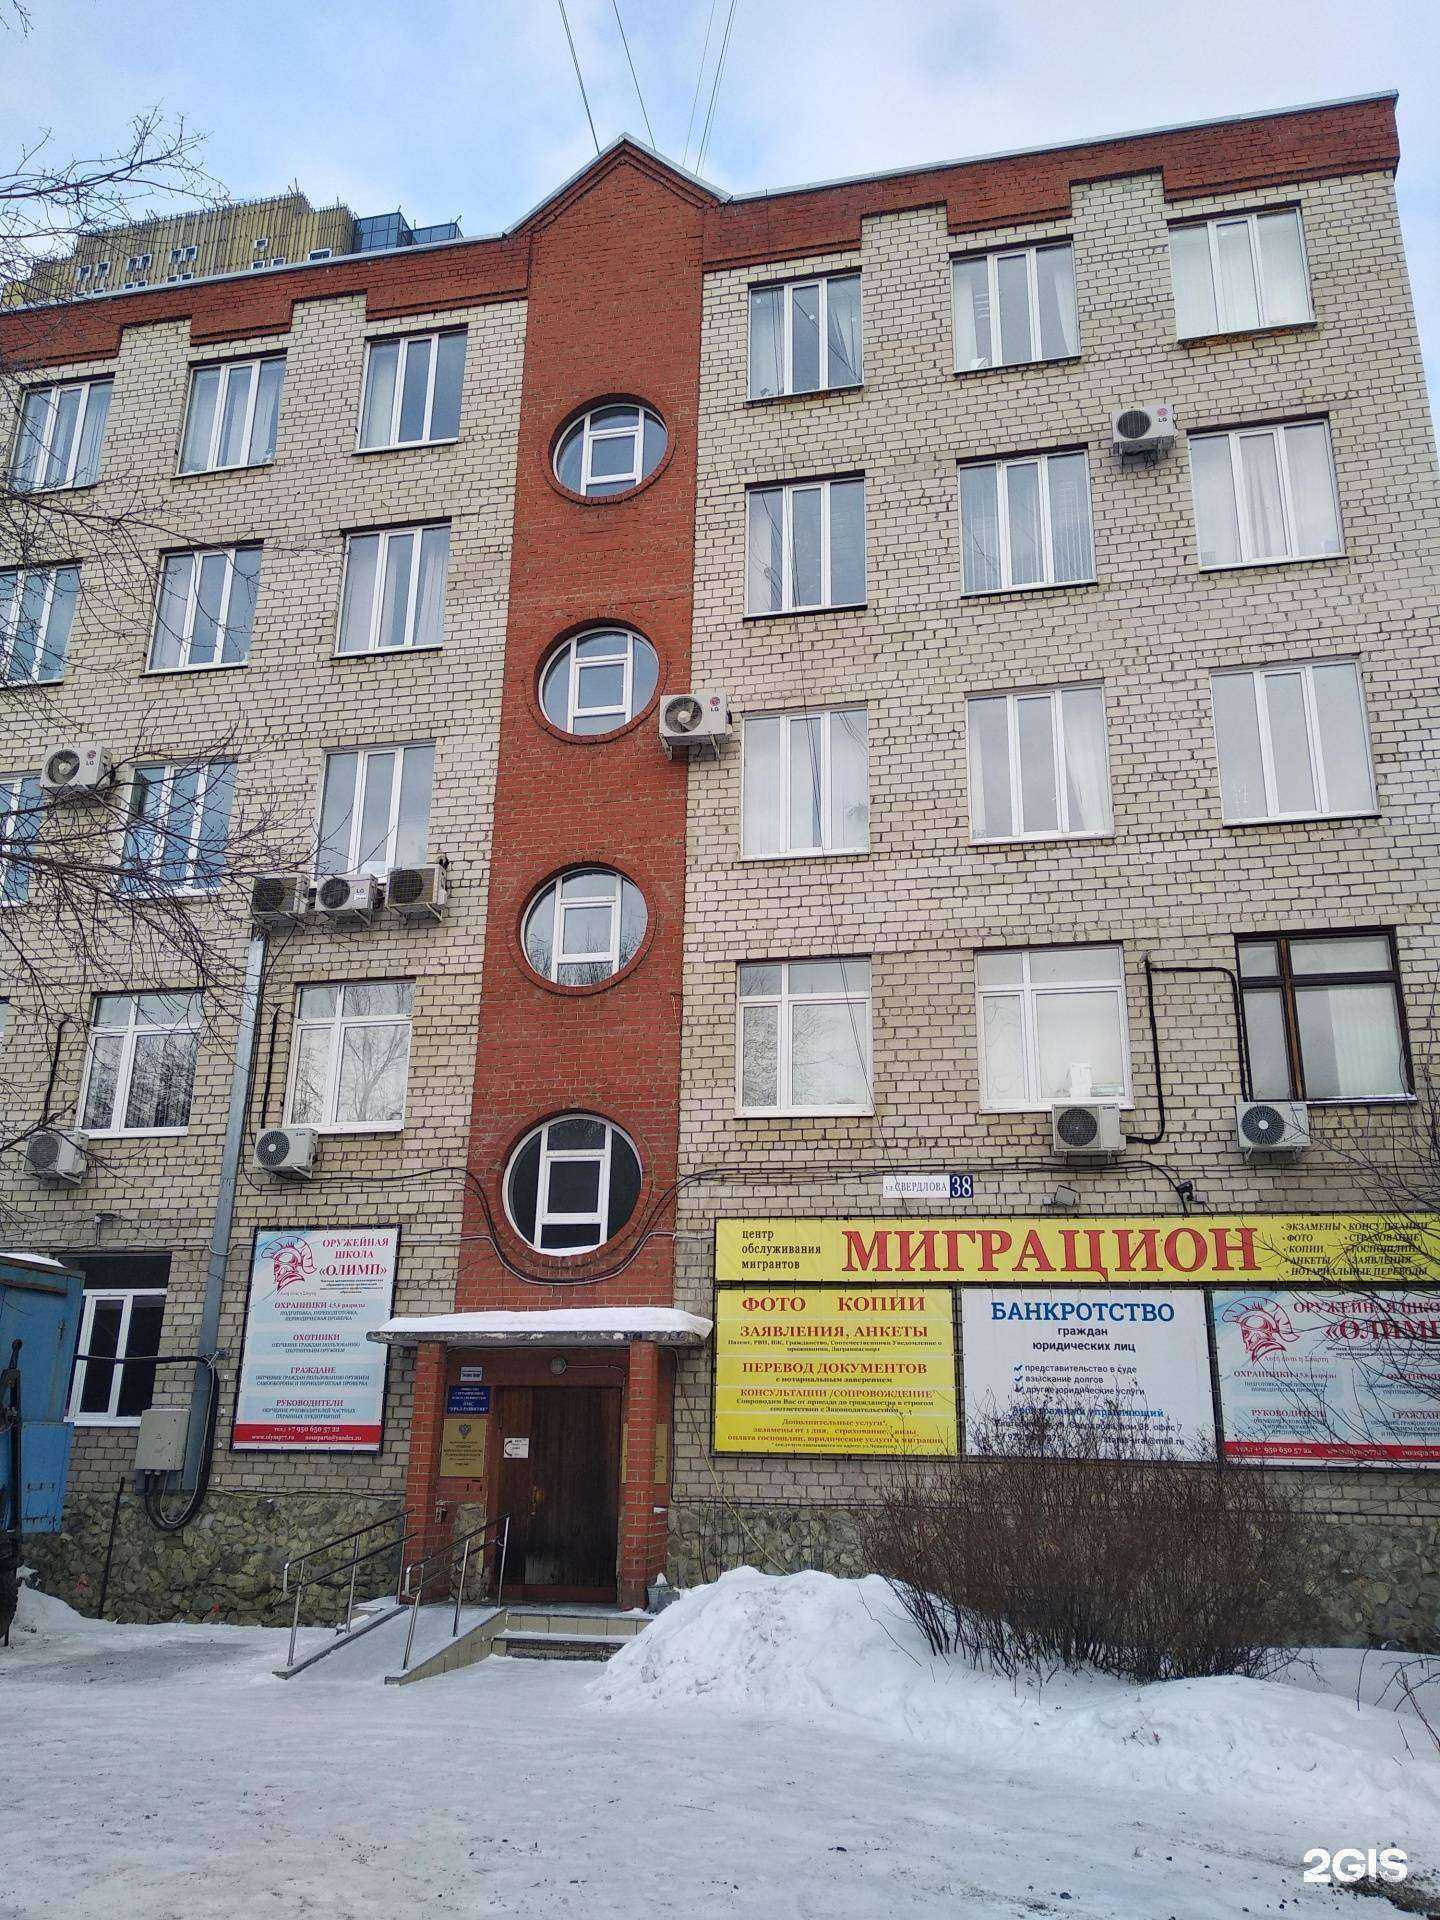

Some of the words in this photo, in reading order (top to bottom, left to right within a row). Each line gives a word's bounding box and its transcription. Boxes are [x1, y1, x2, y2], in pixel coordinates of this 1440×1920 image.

[895, 1182, 947, 1193] СВЕРДЛОВА
[951, 1175, 972, 1197] 38
[742, 1230, 774, 1241] центр
[1287, 1234, 1313, 1242] ФОТО
[322, 1237, 389, 1247] ОРУЖЕЙНАЯ
[335, 1250, 374, 1259] ШКОЛА
[742, 1244, 821, 1256] обслуживания
[841, 1227, 1262, 1281] МИГРАЦИОН
[1289, 1245, 1324, 1253] КОПИИ
[319, 1264, 387, 1276] «ОЛИМП»
[742, 1260, 800, 1271] мигрантов
[741, 1297, 806, 1312] ФОТО
[838, 1296, 925, 1312] КОПИИ
[991, 1302, 1175, 1322] БАНКРОТСТВО
[293, 1333, 340, 1341] ОХОТНИКИ
[740, 1326, 849, 1339] ЗАЯВЛЕНИЯ,
[854, 1326, 928, 1337] АНКЕТЫ
[1057, 1326, 1108, 1337] граждан
[1032, 1341, 1110, 1352] юридических
[1113, 1342, 1136, 1353] лиц
[290, 1366, 337, 1374] ГРАЖДАНЕ
[742, 1362, 814, 1375] ПЕРЕВОД
[817, 1362, 928, 1375] ДОКУМЕНТОВ
[1025, 1364, 1108, 1374] представительство
[1117, 1366, 1137, 1374] суде
[1025, 1375, 1072, 1383] взыскание
[1074, 1376, 1104, 1384] долгов
[740, 1389, 826, 1397] КОНСУЛЬТАЦИИ
[276, 1399, 344, 1407] РУКОВОДИТЕЛИ
